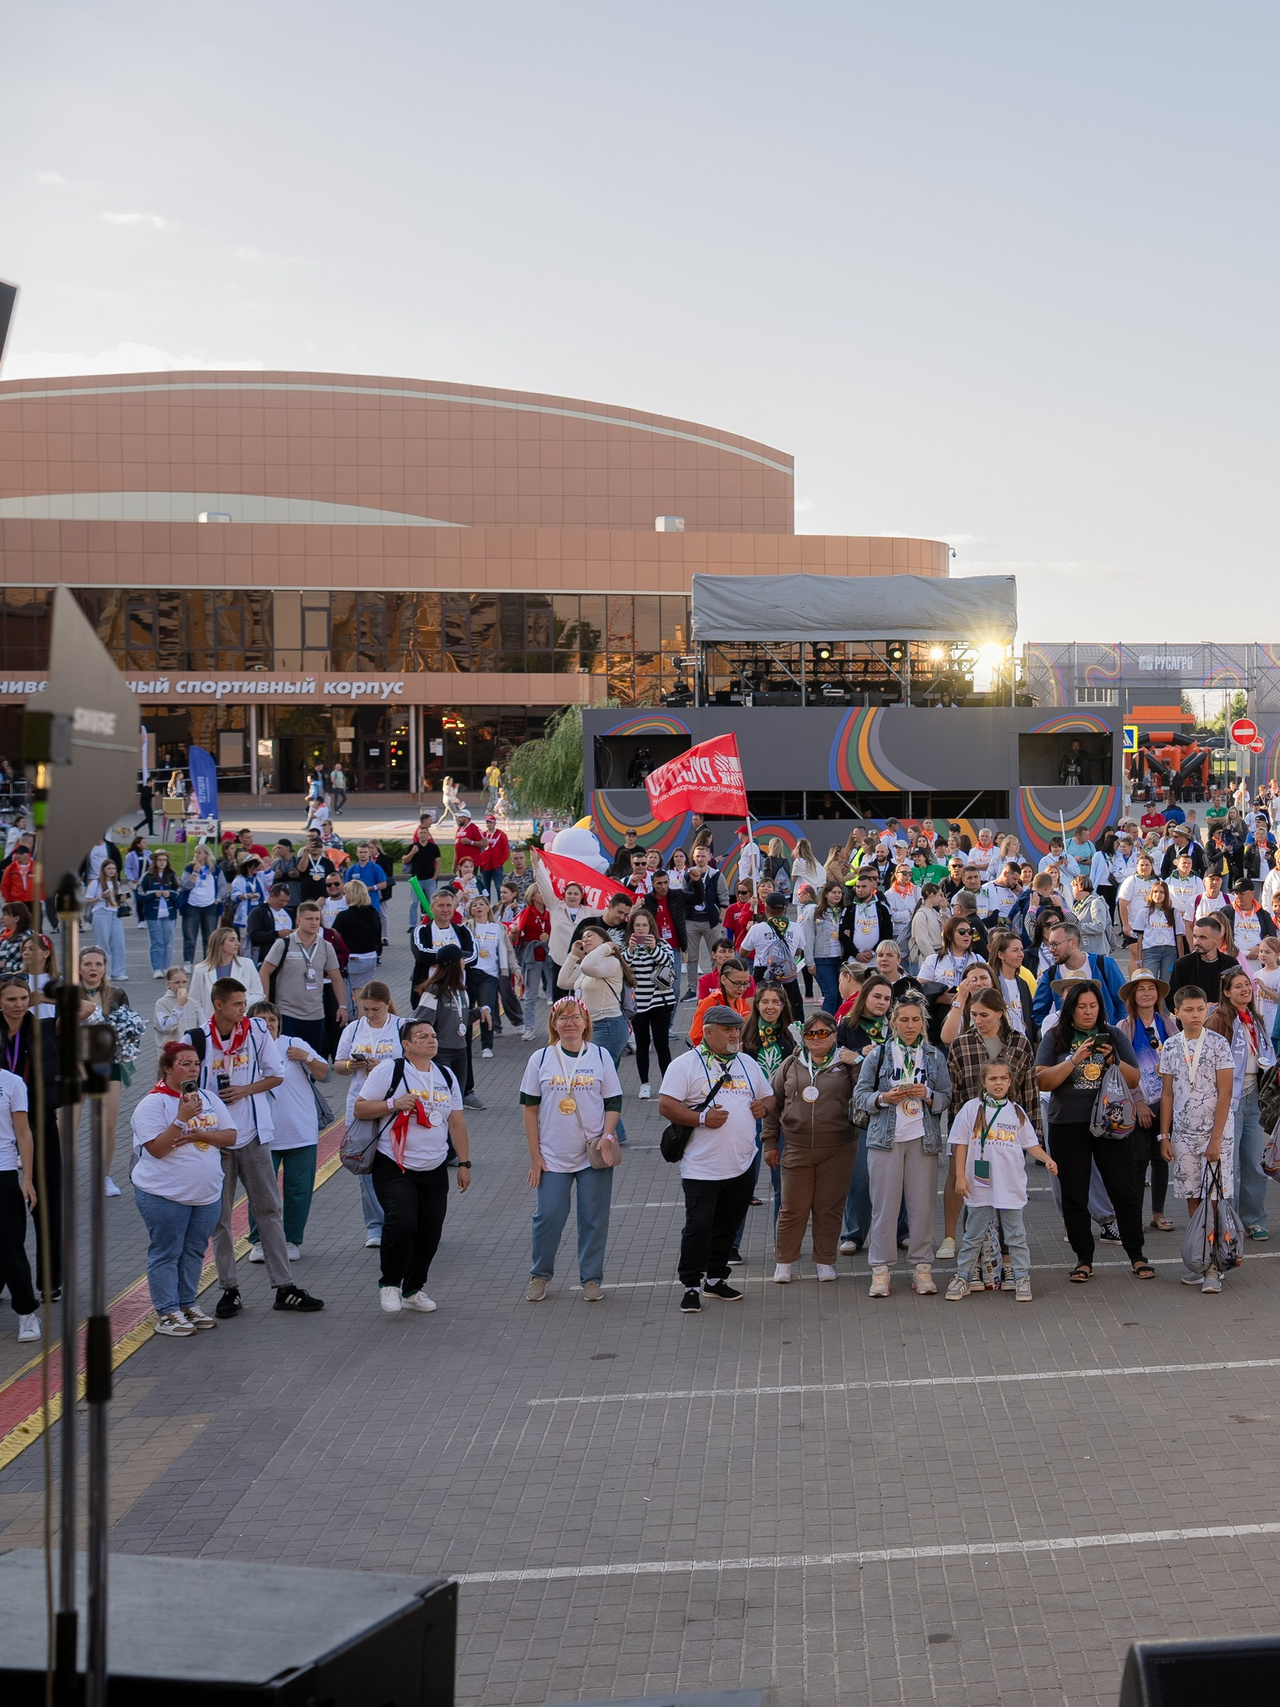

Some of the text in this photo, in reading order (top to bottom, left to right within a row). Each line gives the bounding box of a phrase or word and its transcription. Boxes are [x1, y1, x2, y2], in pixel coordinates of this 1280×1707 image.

[1154, 656, 1193, 670] РУСАГРО
[175, 677, 316, 699] спортивный
[323, 680, 404, 699] корпус
